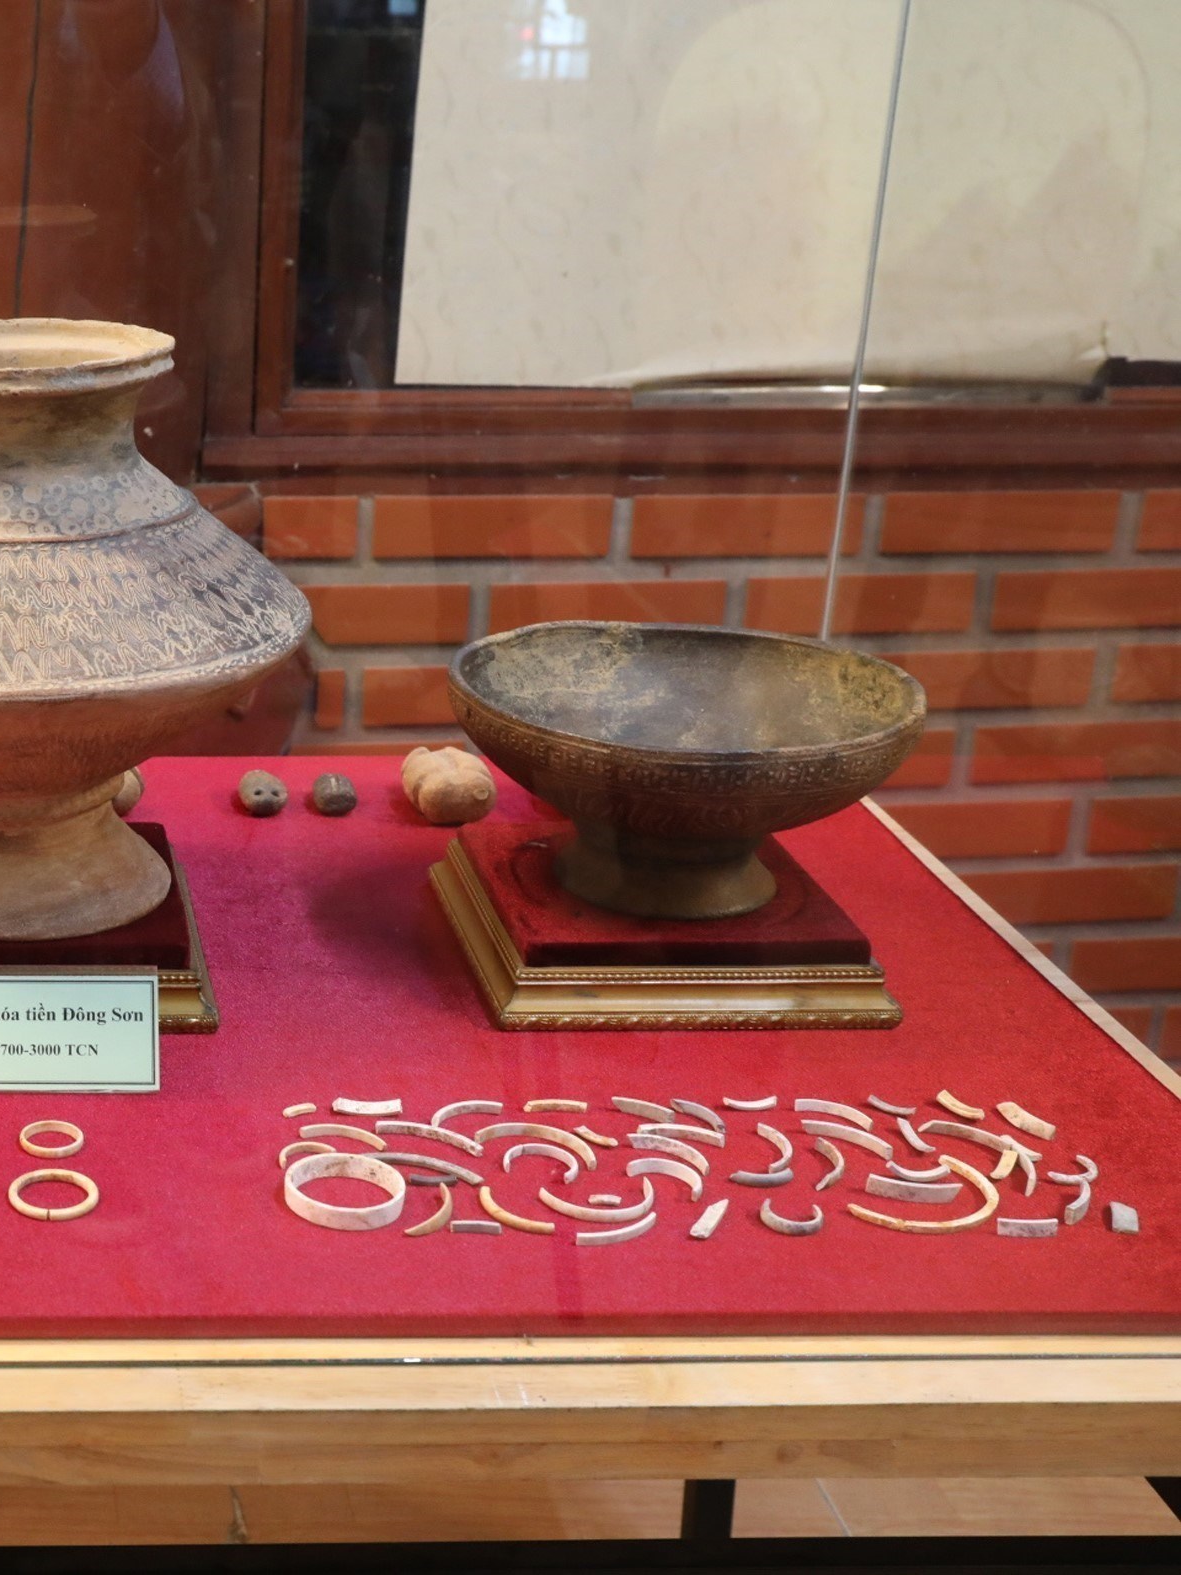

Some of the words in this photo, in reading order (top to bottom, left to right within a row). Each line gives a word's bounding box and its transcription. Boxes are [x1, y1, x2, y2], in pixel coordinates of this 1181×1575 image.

[25, 1001, 57, 1022] tiền
[62, 1006, 107, 1025] Đông
[111, 1006, 144, 1022] Sơn
[65, 1043, 99, 1057] TCN
